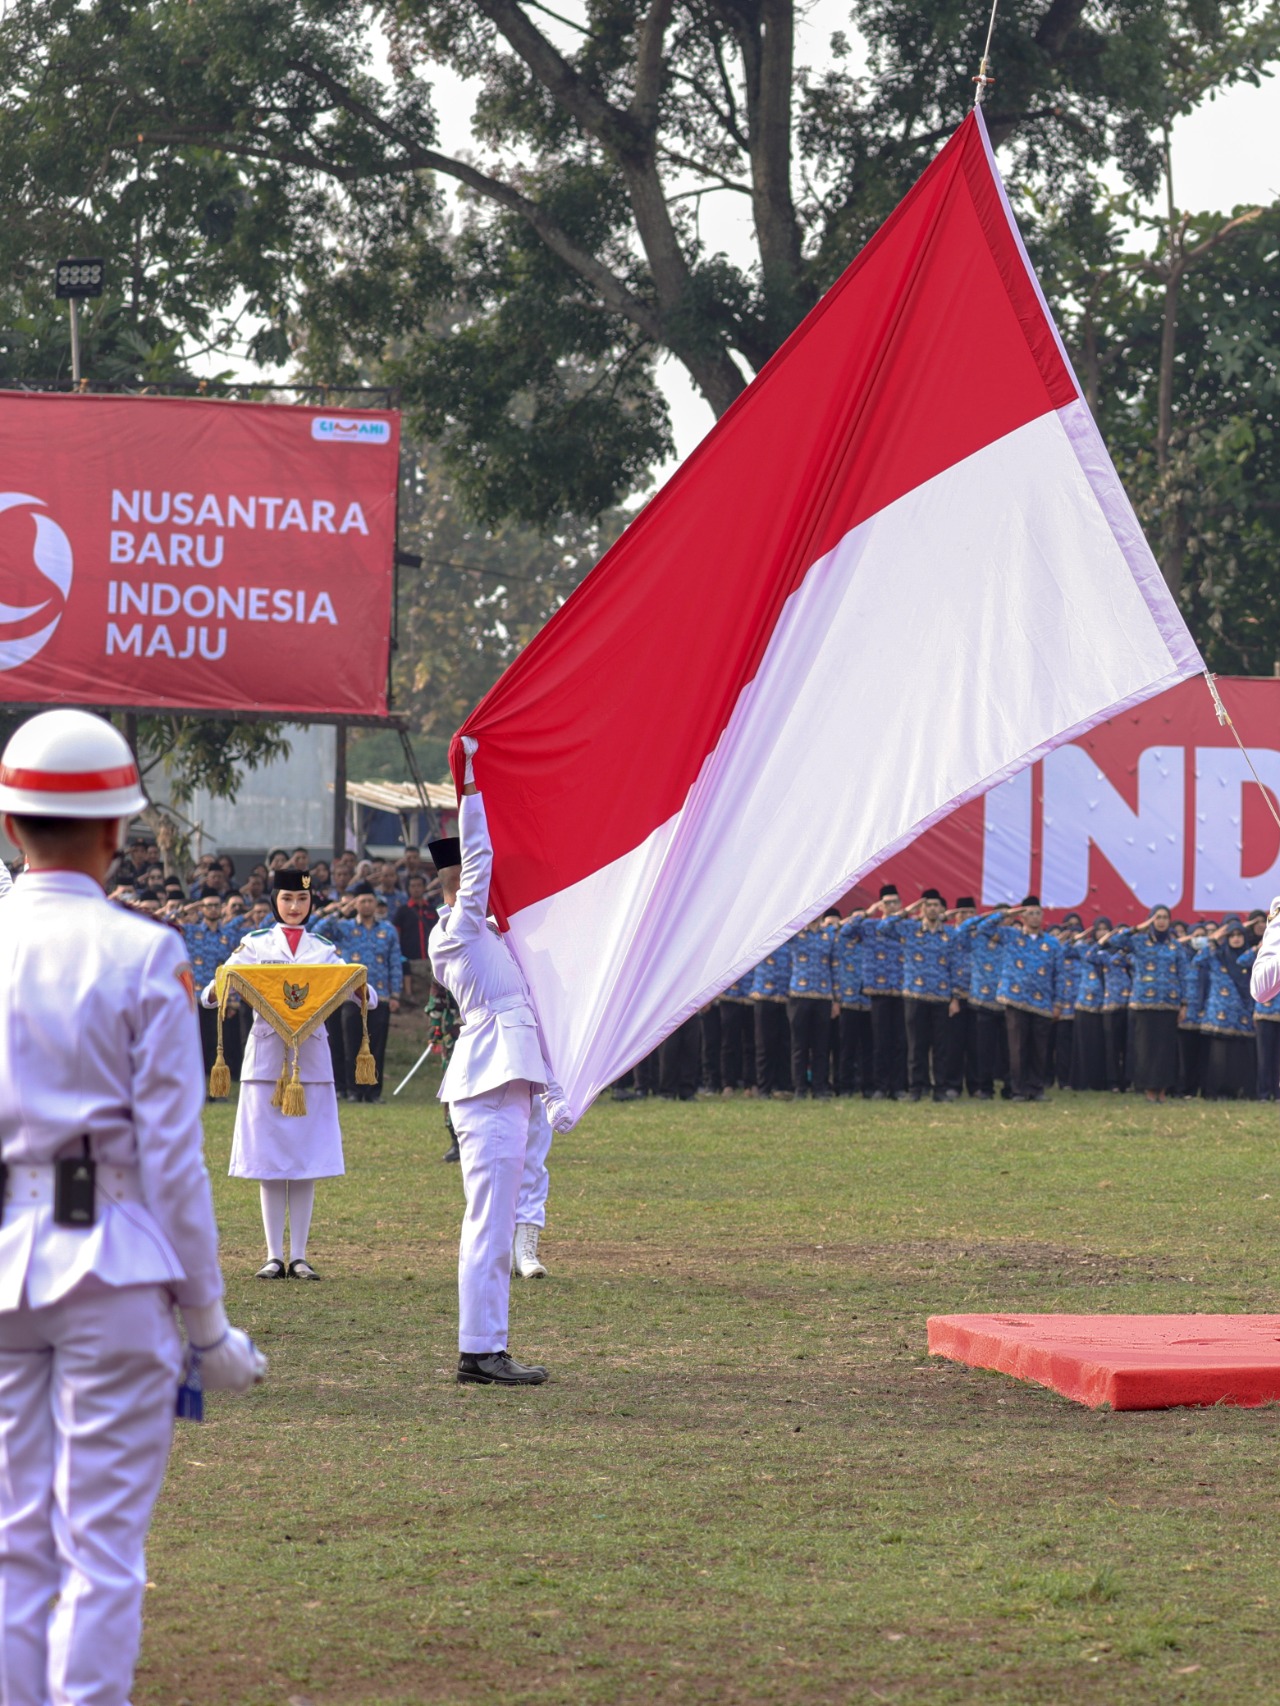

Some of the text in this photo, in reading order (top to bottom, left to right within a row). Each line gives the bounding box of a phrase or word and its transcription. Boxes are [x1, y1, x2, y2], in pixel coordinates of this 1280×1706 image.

[111, 489, 369, 535] NUSANTARA
[109, 530, 225, 568] BARU
[107, 580, 339, 625] INDONESIA
[105, 622, 228, 660] MAJU
